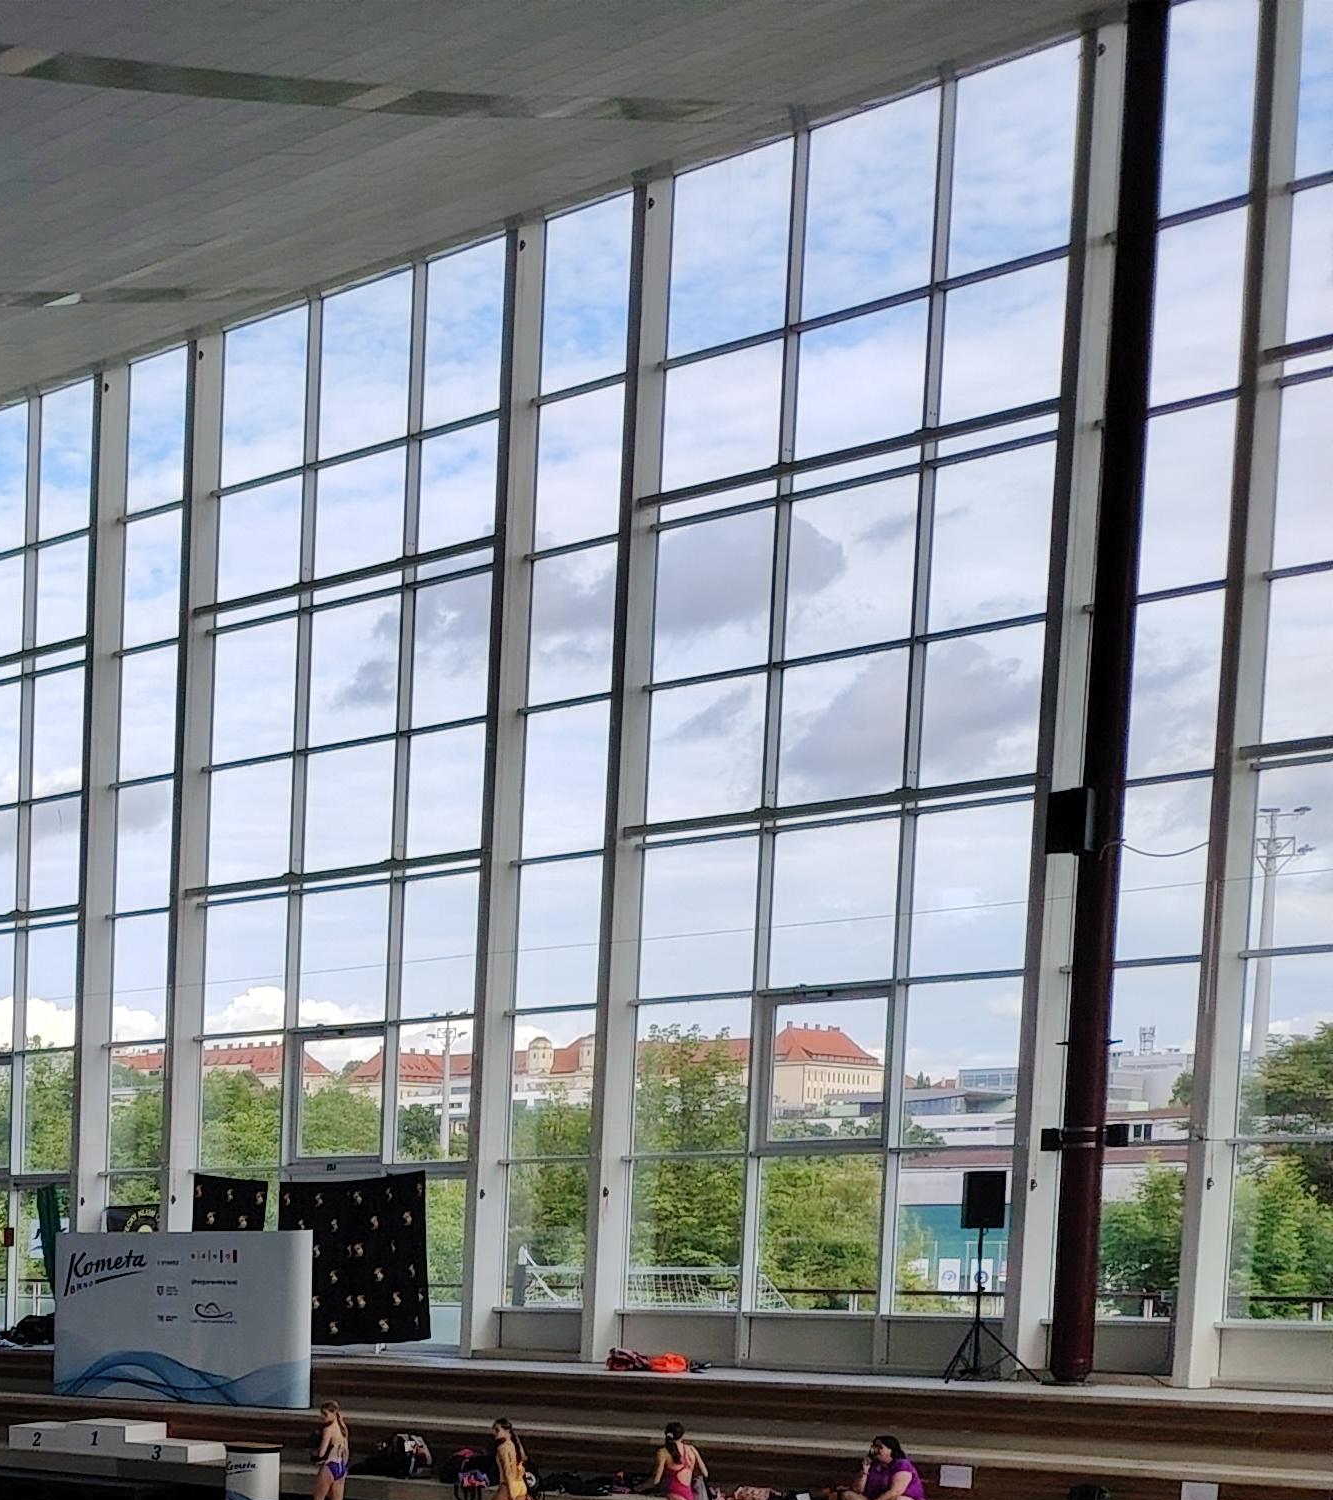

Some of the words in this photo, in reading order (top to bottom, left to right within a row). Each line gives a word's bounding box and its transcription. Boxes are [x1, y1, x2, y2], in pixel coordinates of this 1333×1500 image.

[63, 1249, 148, 1296] Kometa
[70, 1281, 94, 1294] BRNO
[32, 1431, 42, 1447] 2
[90, 1431, 99, 1446] 1
[151, 1445, 162, 1461] 3
